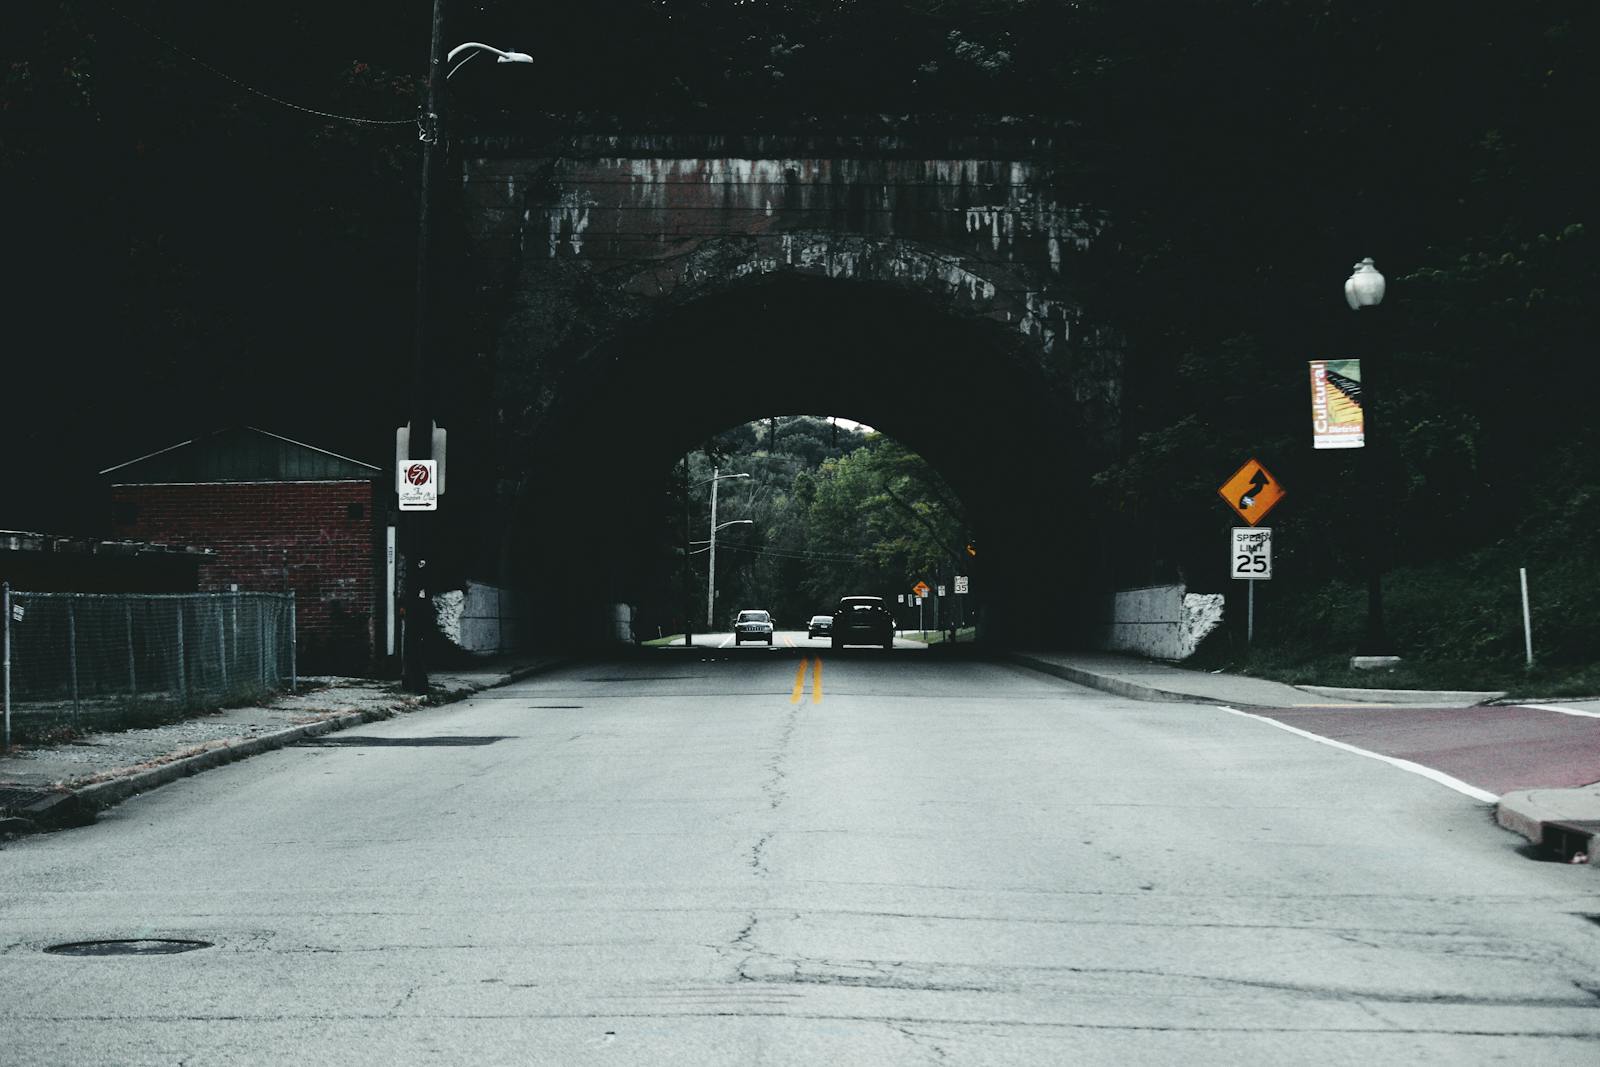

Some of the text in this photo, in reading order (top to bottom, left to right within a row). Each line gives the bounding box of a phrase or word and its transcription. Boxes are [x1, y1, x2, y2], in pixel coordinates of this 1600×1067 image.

[1311, 364, 1327, 433] Cultural
[1236, 534, 1268, 542] SPEED
[1240, 544, 1263, 552] LIMIT
[1236, 555, 1267, 573] 25
[956, 584, 967, 592] 35
